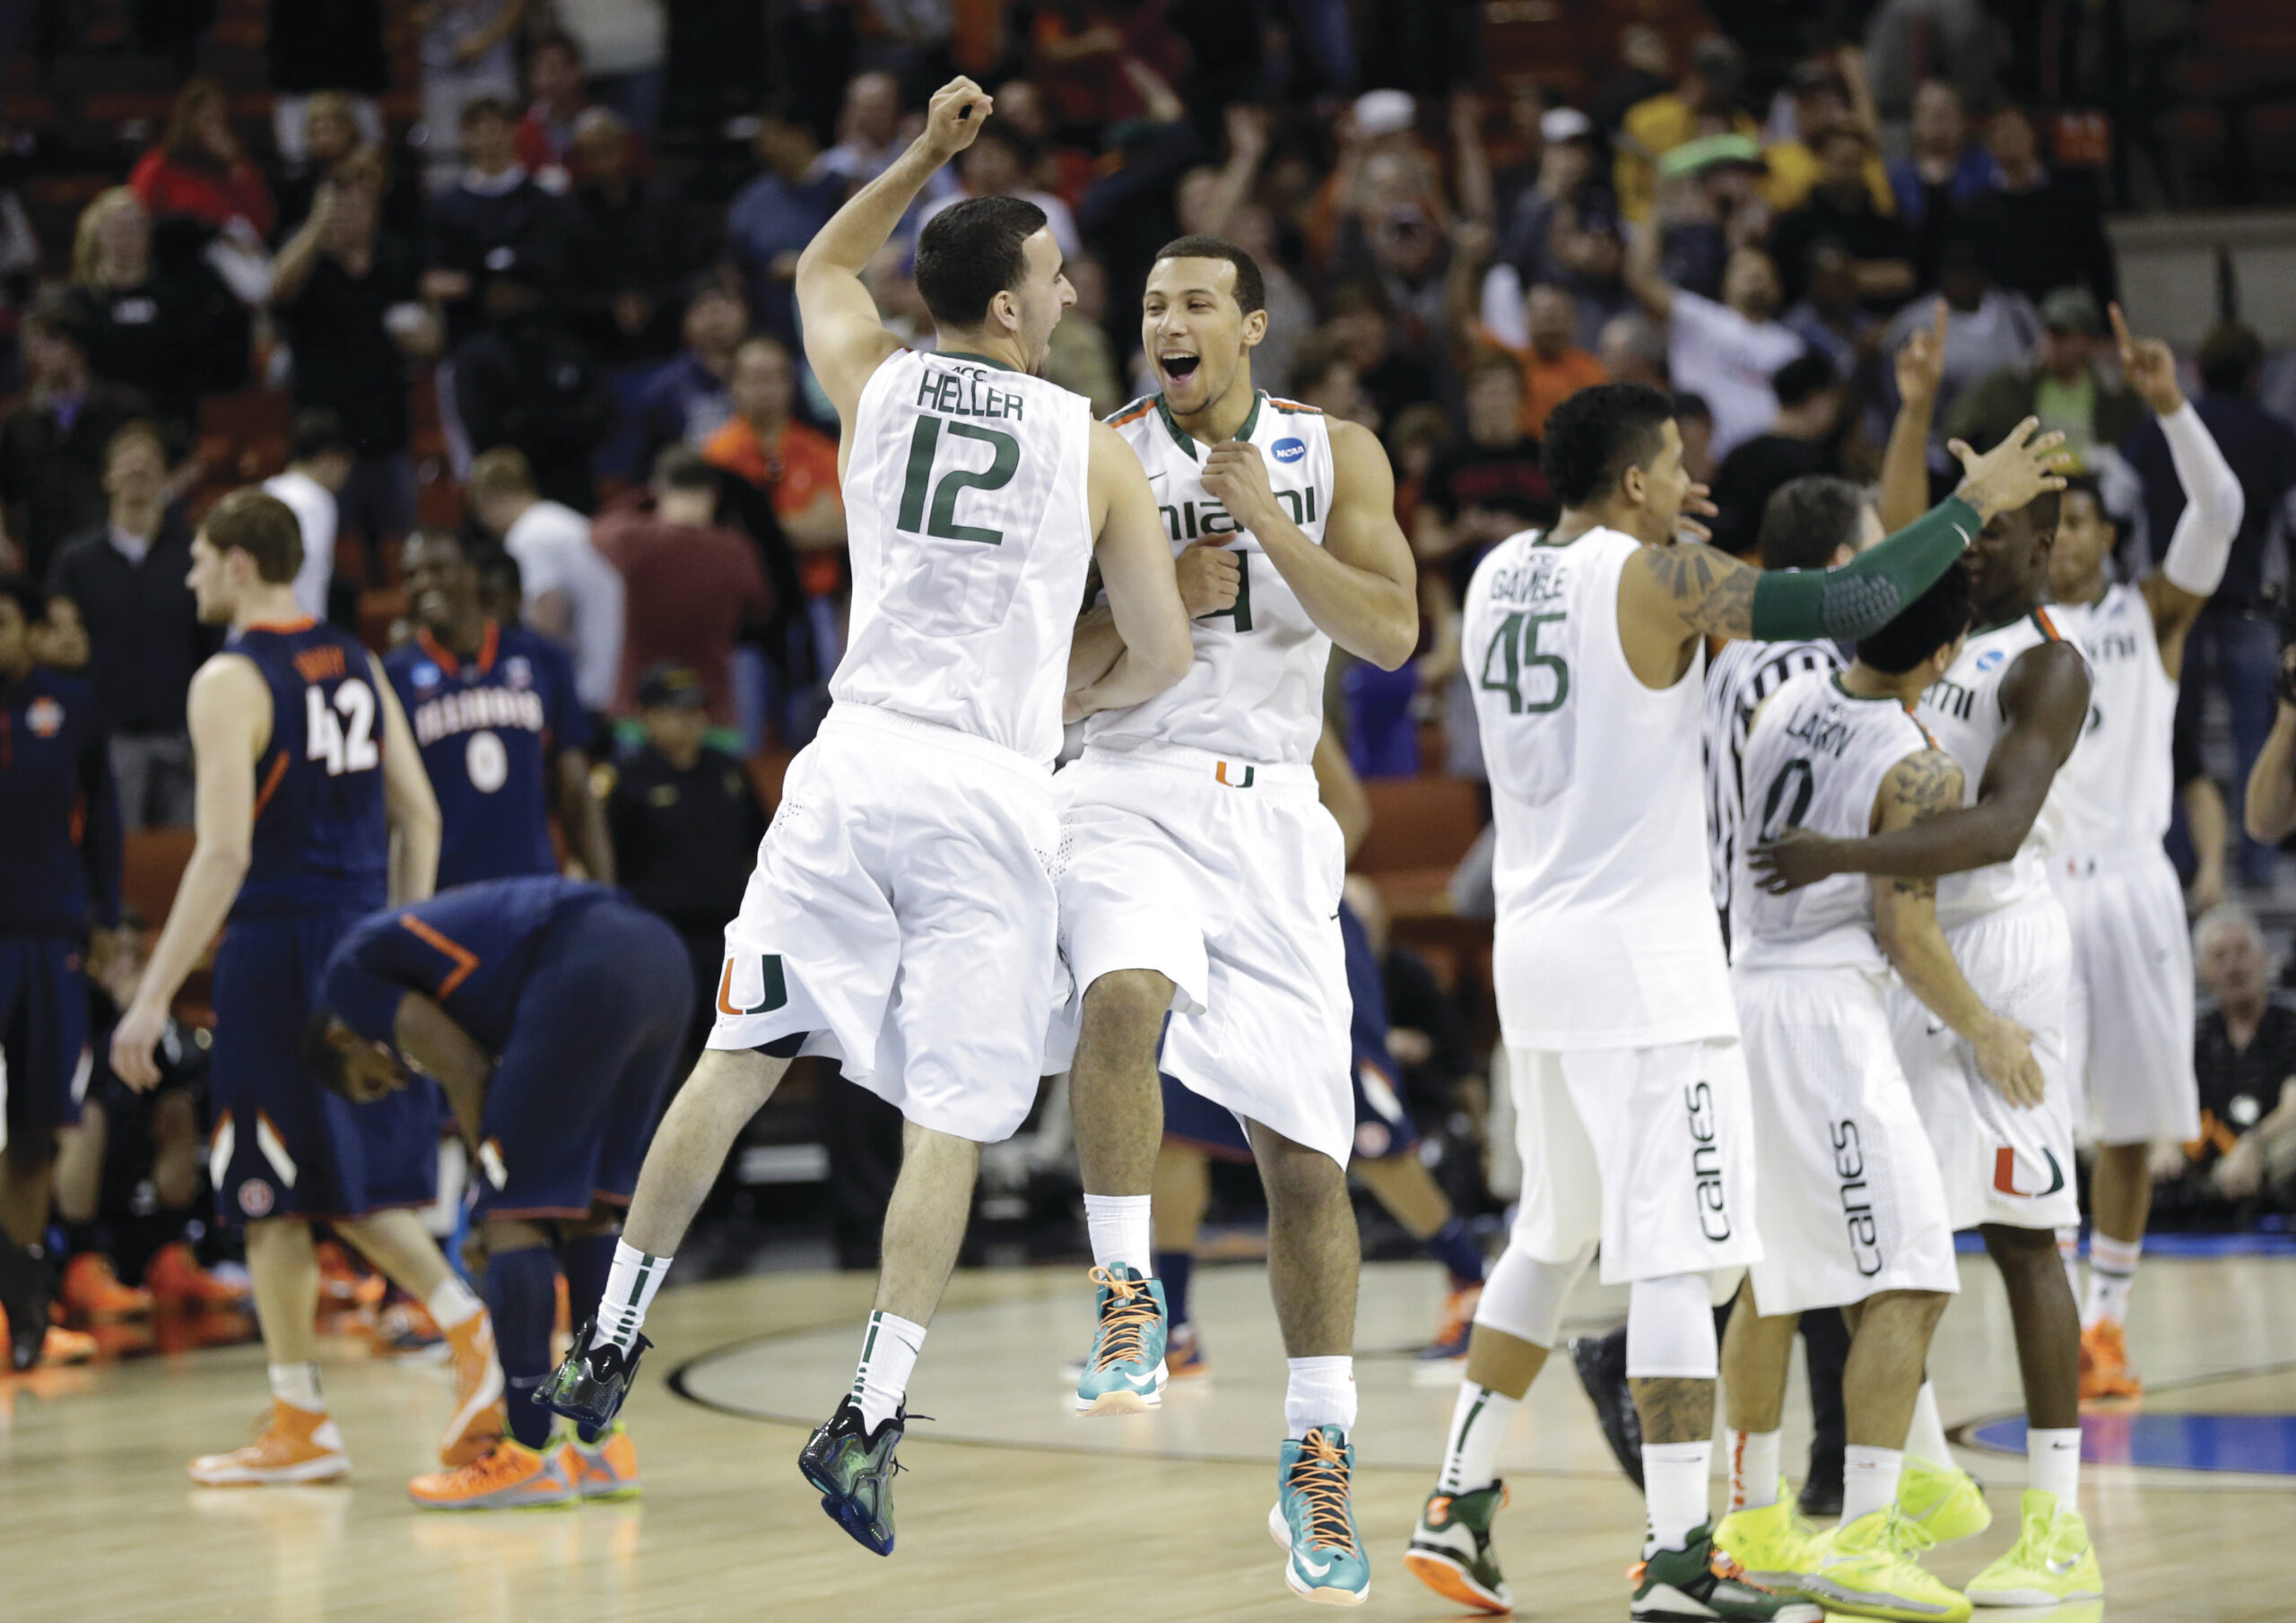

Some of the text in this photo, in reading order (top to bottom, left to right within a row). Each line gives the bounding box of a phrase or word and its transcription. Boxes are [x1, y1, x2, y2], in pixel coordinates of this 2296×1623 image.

[917, 369, 1023, 421] HELLER
[897, 414, 1021, 545] 12
[1481, 612, 1569, 715] 45
[305, 678, 379, 777] 42
[465, 729, 509, 794] 0
[1215, 760, 1255, 788] U
[1758, 759, 1813, 843] 0
[718, 954, 788, 1015] U
[1994, 1147, 2065, 1197] U
